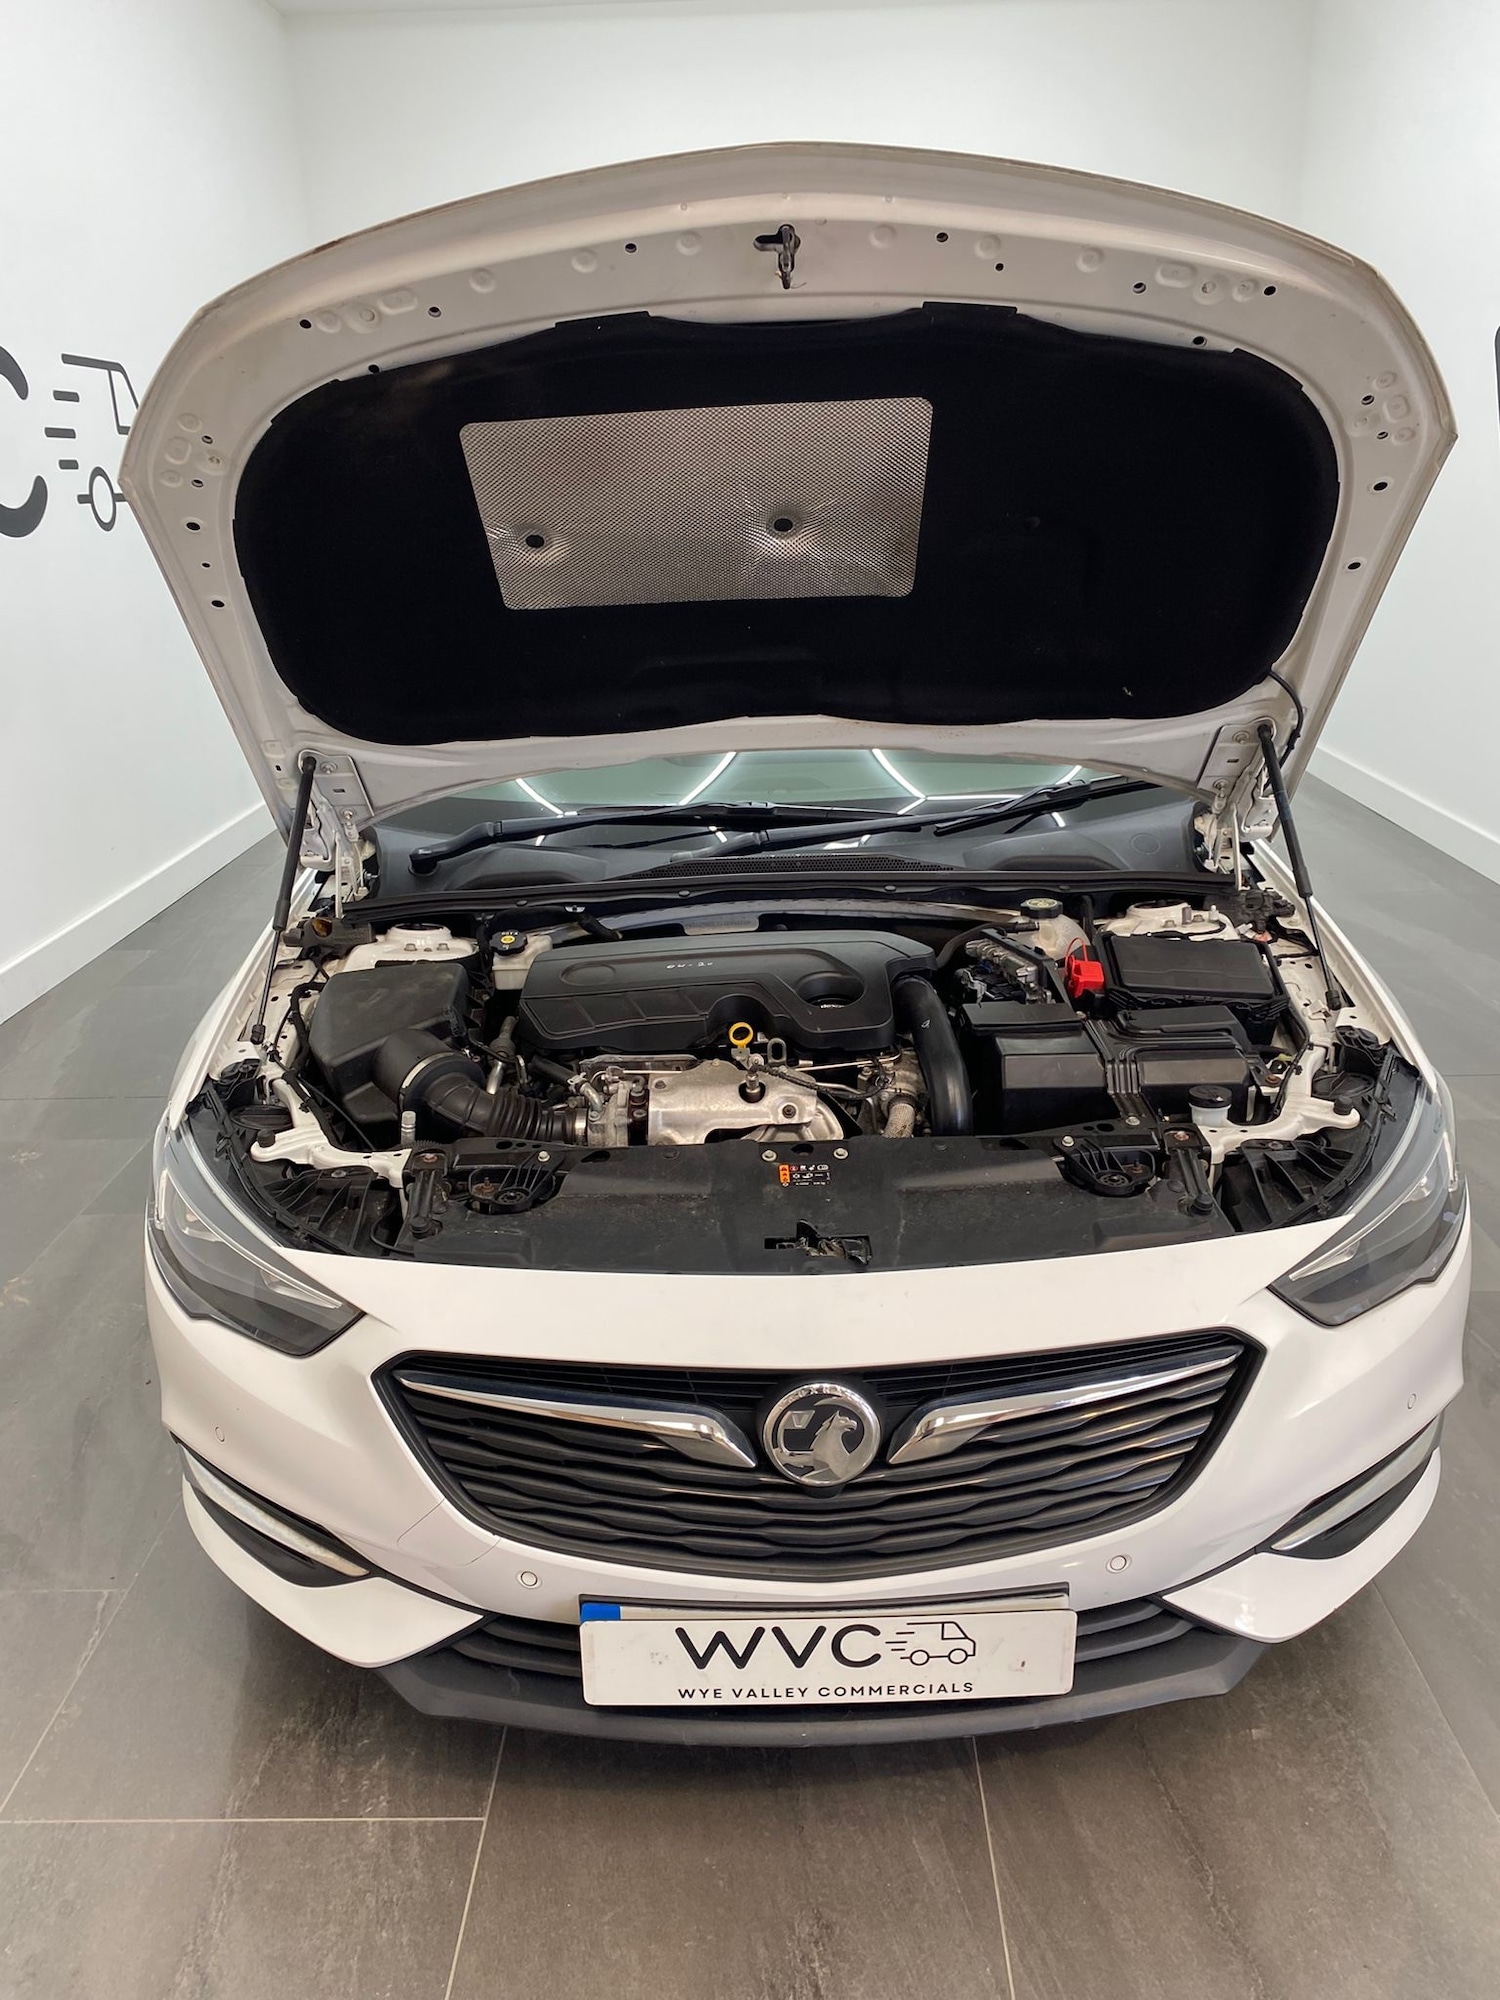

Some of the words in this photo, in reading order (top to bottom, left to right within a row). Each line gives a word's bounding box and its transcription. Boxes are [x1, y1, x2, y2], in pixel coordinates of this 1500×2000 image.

[675, 1623, 882, 1670] WVC
[678, 1688, 722, 1699] WYE
[731, 1688, 808, 1699] VALLEY
[818, 1683, 973, 1697] COMMERCIALS
